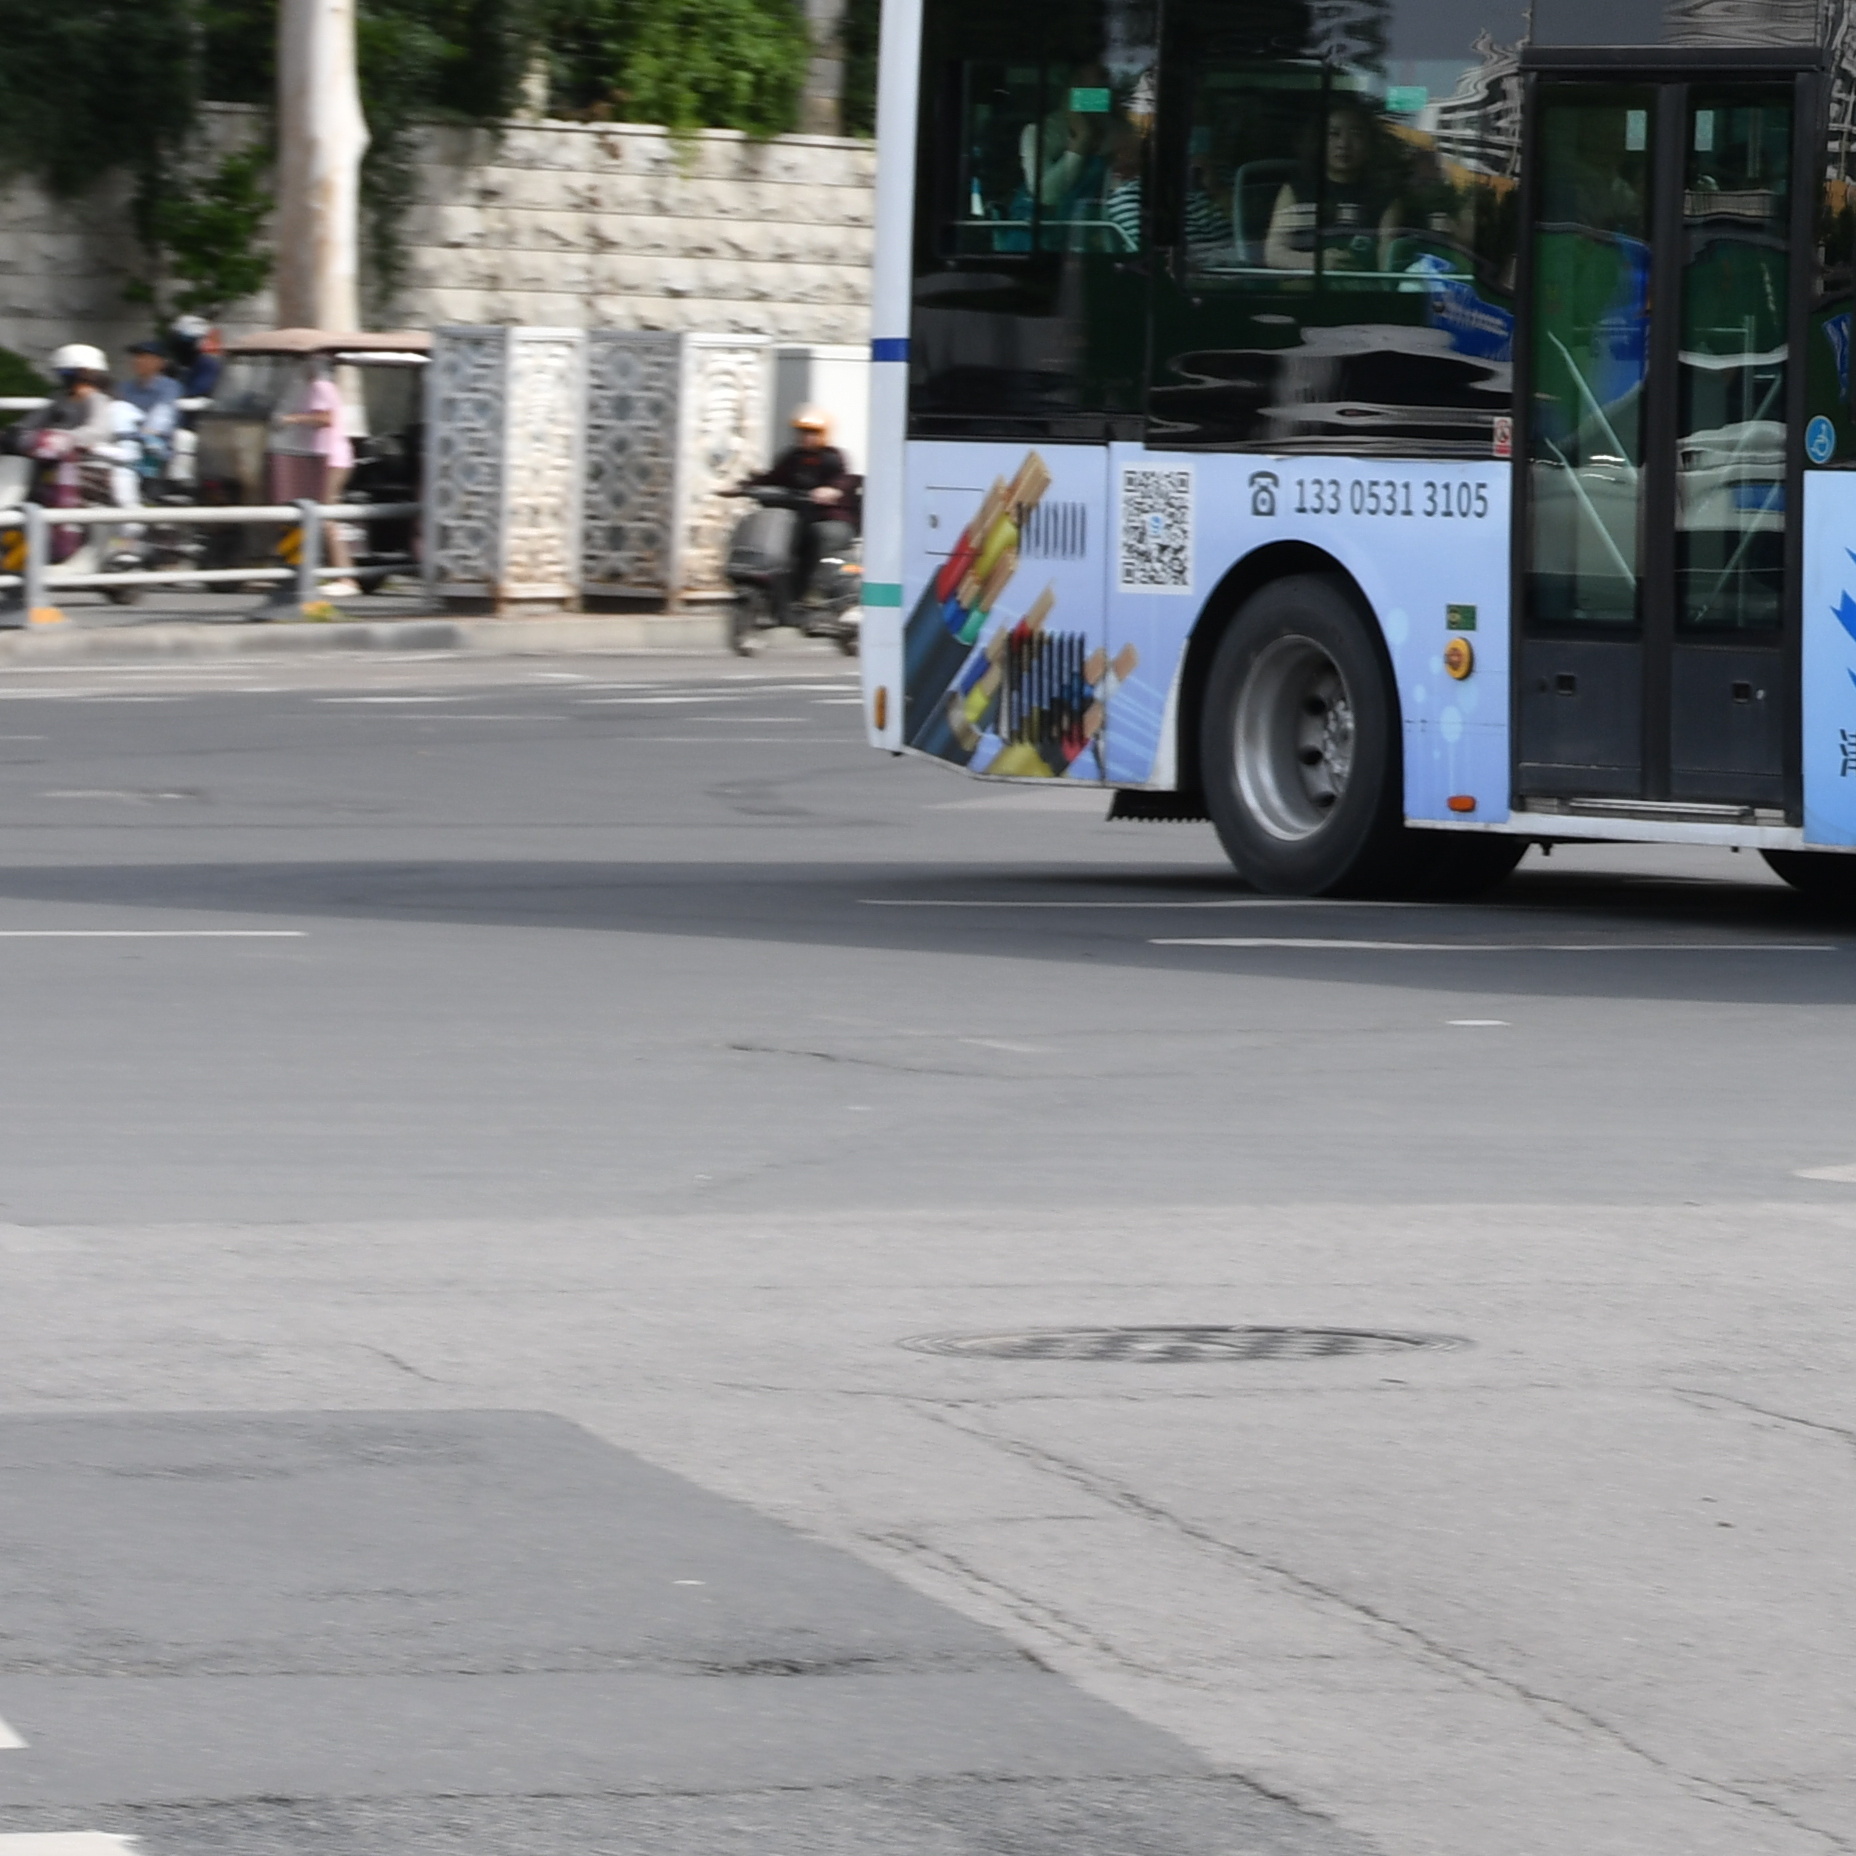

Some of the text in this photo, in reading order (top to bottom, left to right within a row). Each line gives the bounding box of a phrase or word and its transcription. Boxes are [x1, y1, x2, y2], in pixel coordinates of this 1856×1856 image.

[1295, 478, 1488, 519] 133 0531 3105
